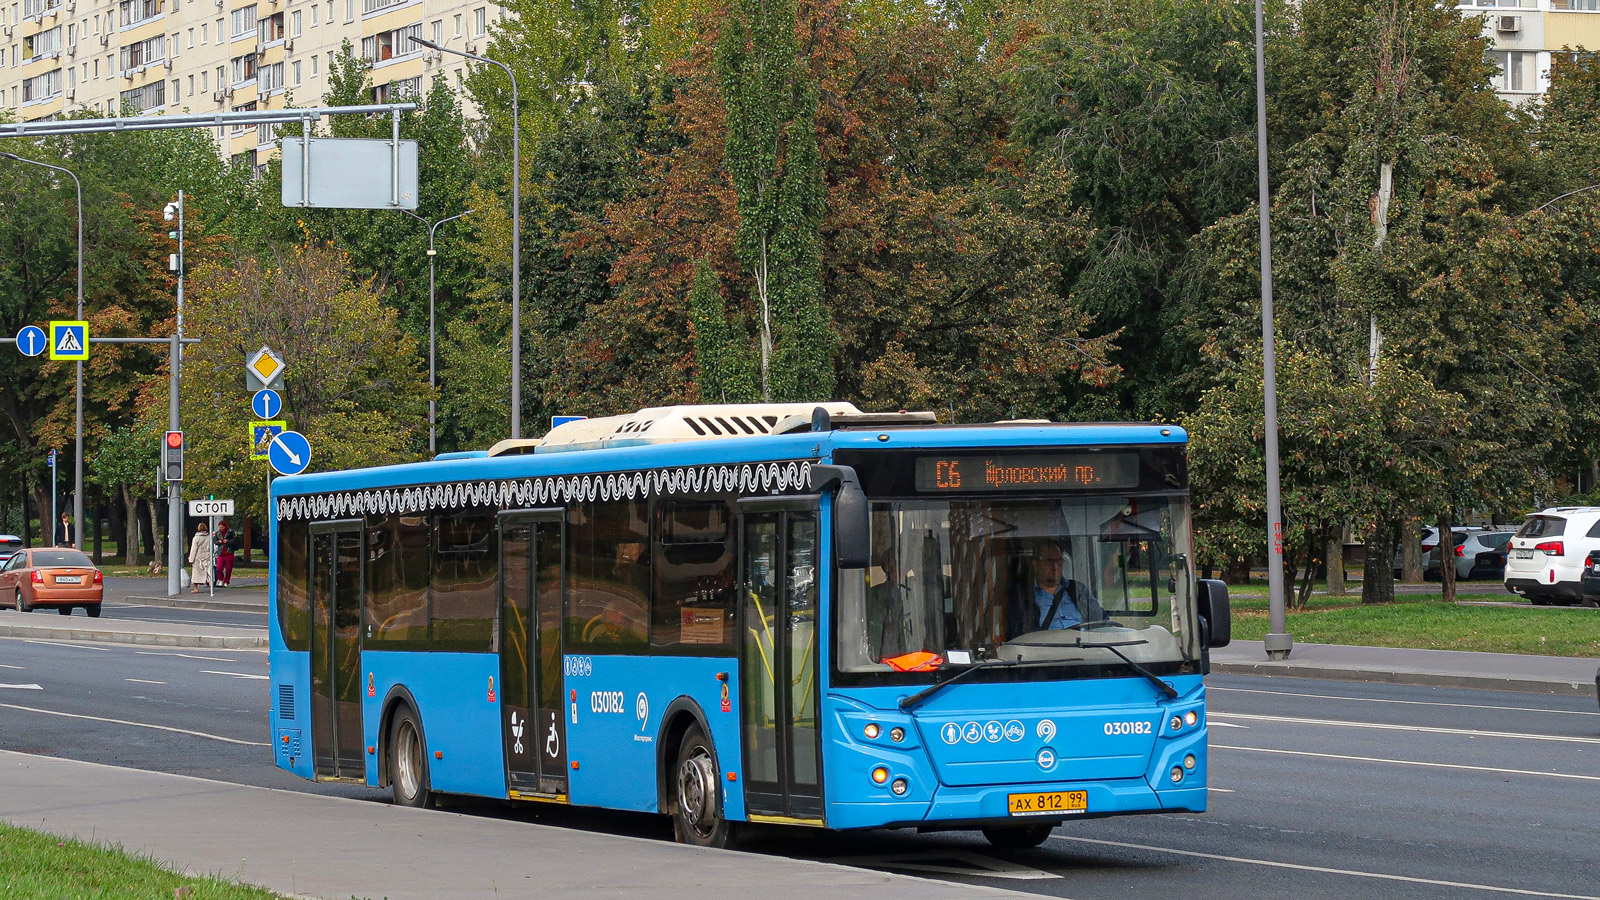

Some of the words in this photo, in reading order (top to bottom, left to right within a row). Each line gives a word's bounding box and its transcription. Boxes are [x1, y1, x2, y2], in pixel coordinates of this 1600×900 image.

[1075, 465, 1101, 485] пр.
[195, 502, 228, 513] СТОП
[591, 691, 625, 713] 030182
[1103, 721, 1152, 735] 030182
[1037, 794, 1062, 809] 812
[1069, 792, 1083, 804] 99
